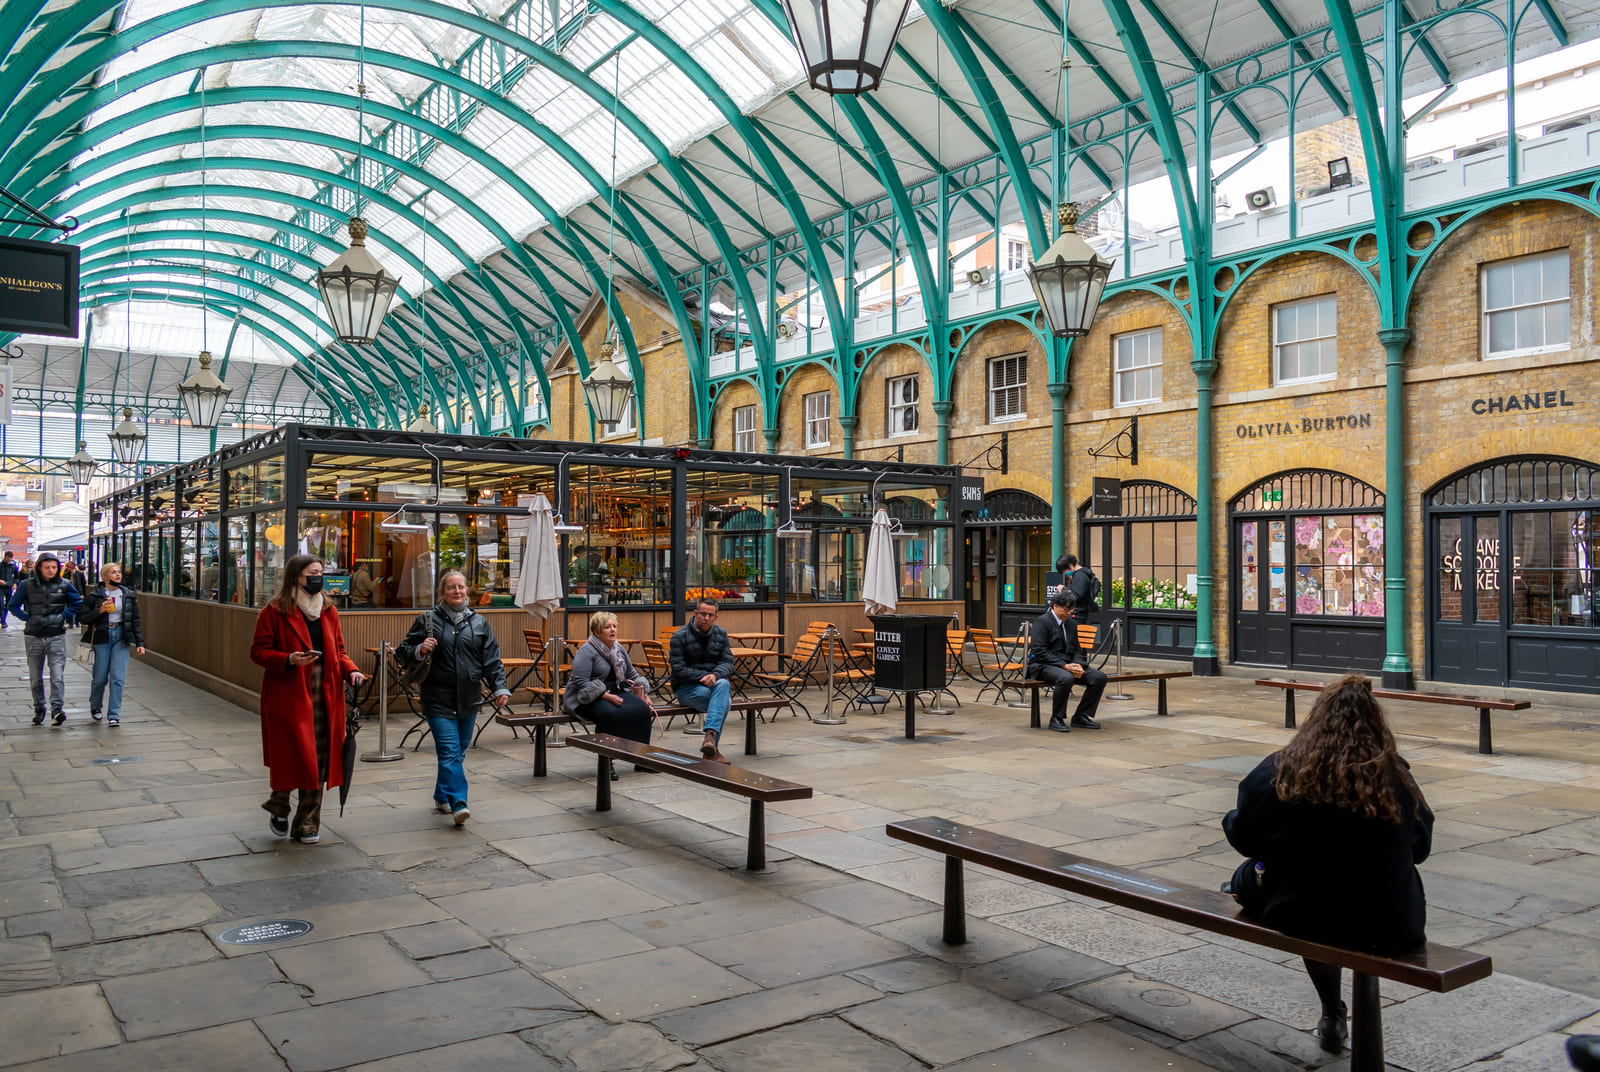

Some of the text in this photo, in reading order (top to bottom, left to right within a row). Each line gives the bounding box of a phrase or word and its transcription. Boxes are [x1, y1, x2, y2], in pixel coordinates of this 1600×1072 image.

[1471, 390, 1573, 415] CHANEL
[1236, 413, 1371, 438] OLIVIA BURTON
[1455, 538, 1500, 556] CANE
[1443, 555, 1500, 573] SCOOL
[875, 631, 901, 642] LITTER
[876, 646, 900, 655] COVENT
[876, 653, 900, 661] GARDEN
[239, 925, 289, 935] OBSERVE
[241, 923, 282, 932] PLEASE
[247, 929, 287, 937] SOCIAL
[236, 929, 302, 943] DISTANCING
